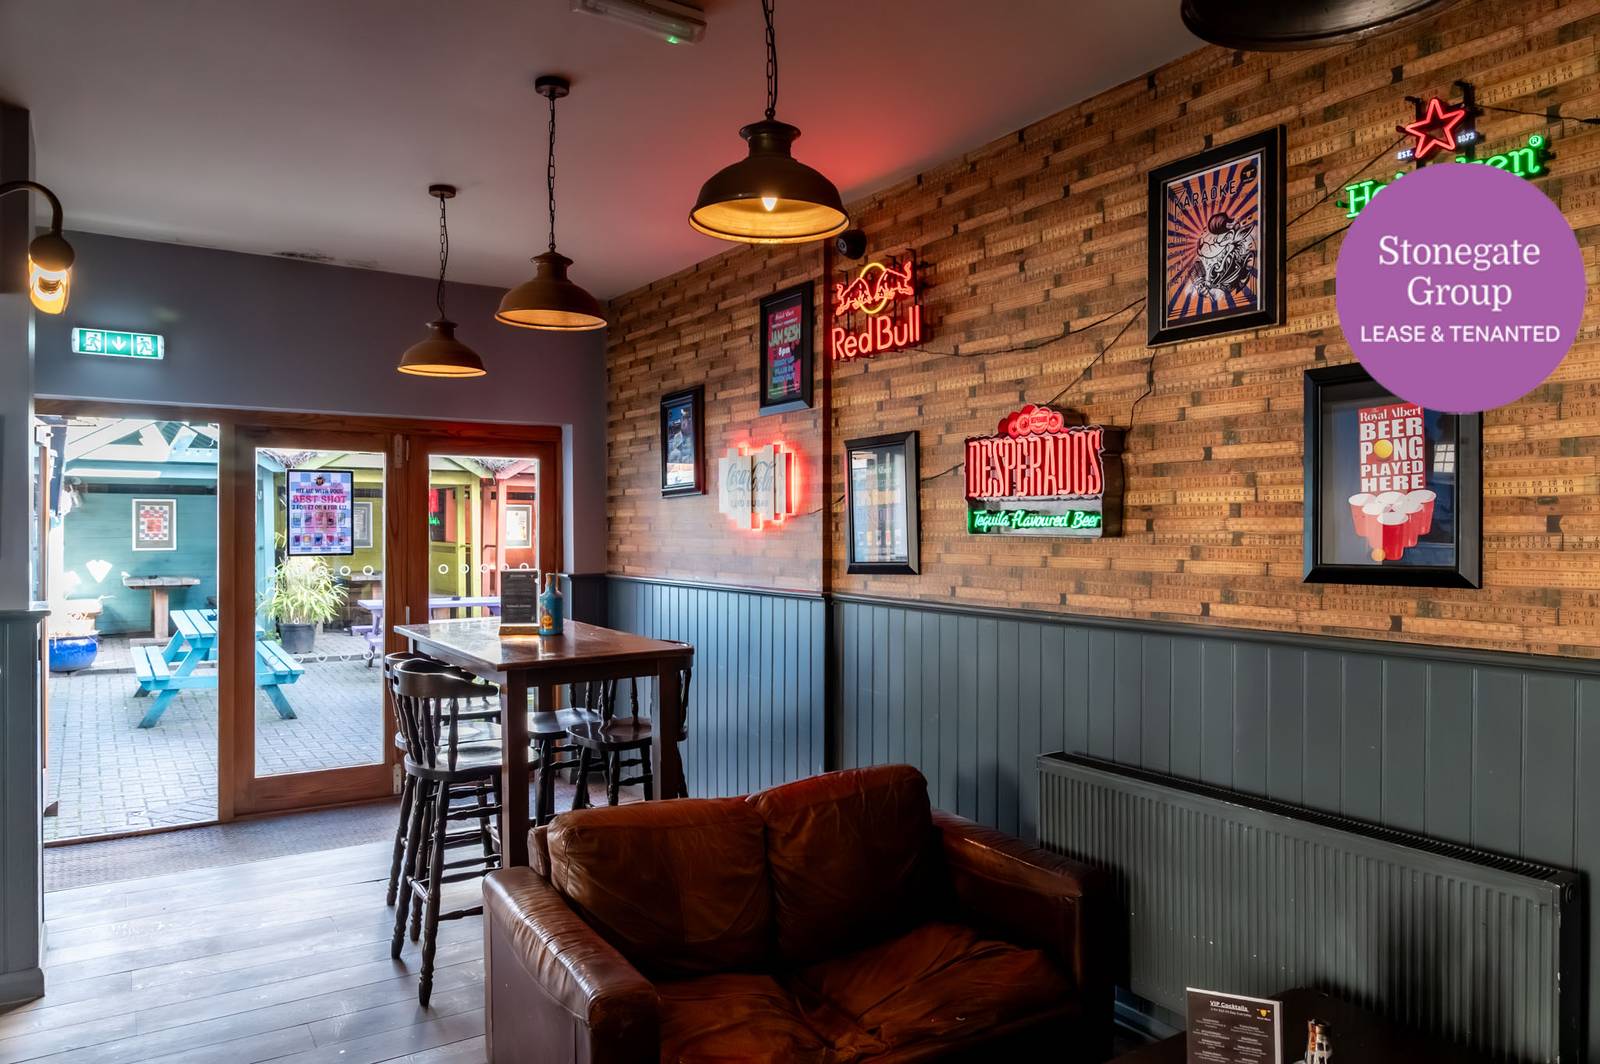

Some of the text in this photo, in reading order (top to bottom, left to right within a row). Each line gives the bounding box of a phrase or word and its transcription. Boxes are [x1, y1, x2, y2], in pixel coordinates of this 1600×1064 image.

[1396, 149, 1413, 161] EST.
[1174, 180, 1237, 220] KARAOKE
[831, 304, 920, 360] Red Bull
[1360, 406, 1421, 423] Royal Albert
[1360, 417, 1423, 441] BEER
[968, 429, 1102, 498] DESPERADOS
[1361, 460, 1423, 477] PLAYED
[1361, 474, 1424, 493] HERE
[293, 495, 347, 503] BEST SHOT
[973, 510, 1010, 532] Tequila
[1071, 511, 1101, 528] Beer
[1221, 1002, 1248, 1011] Cocktails
